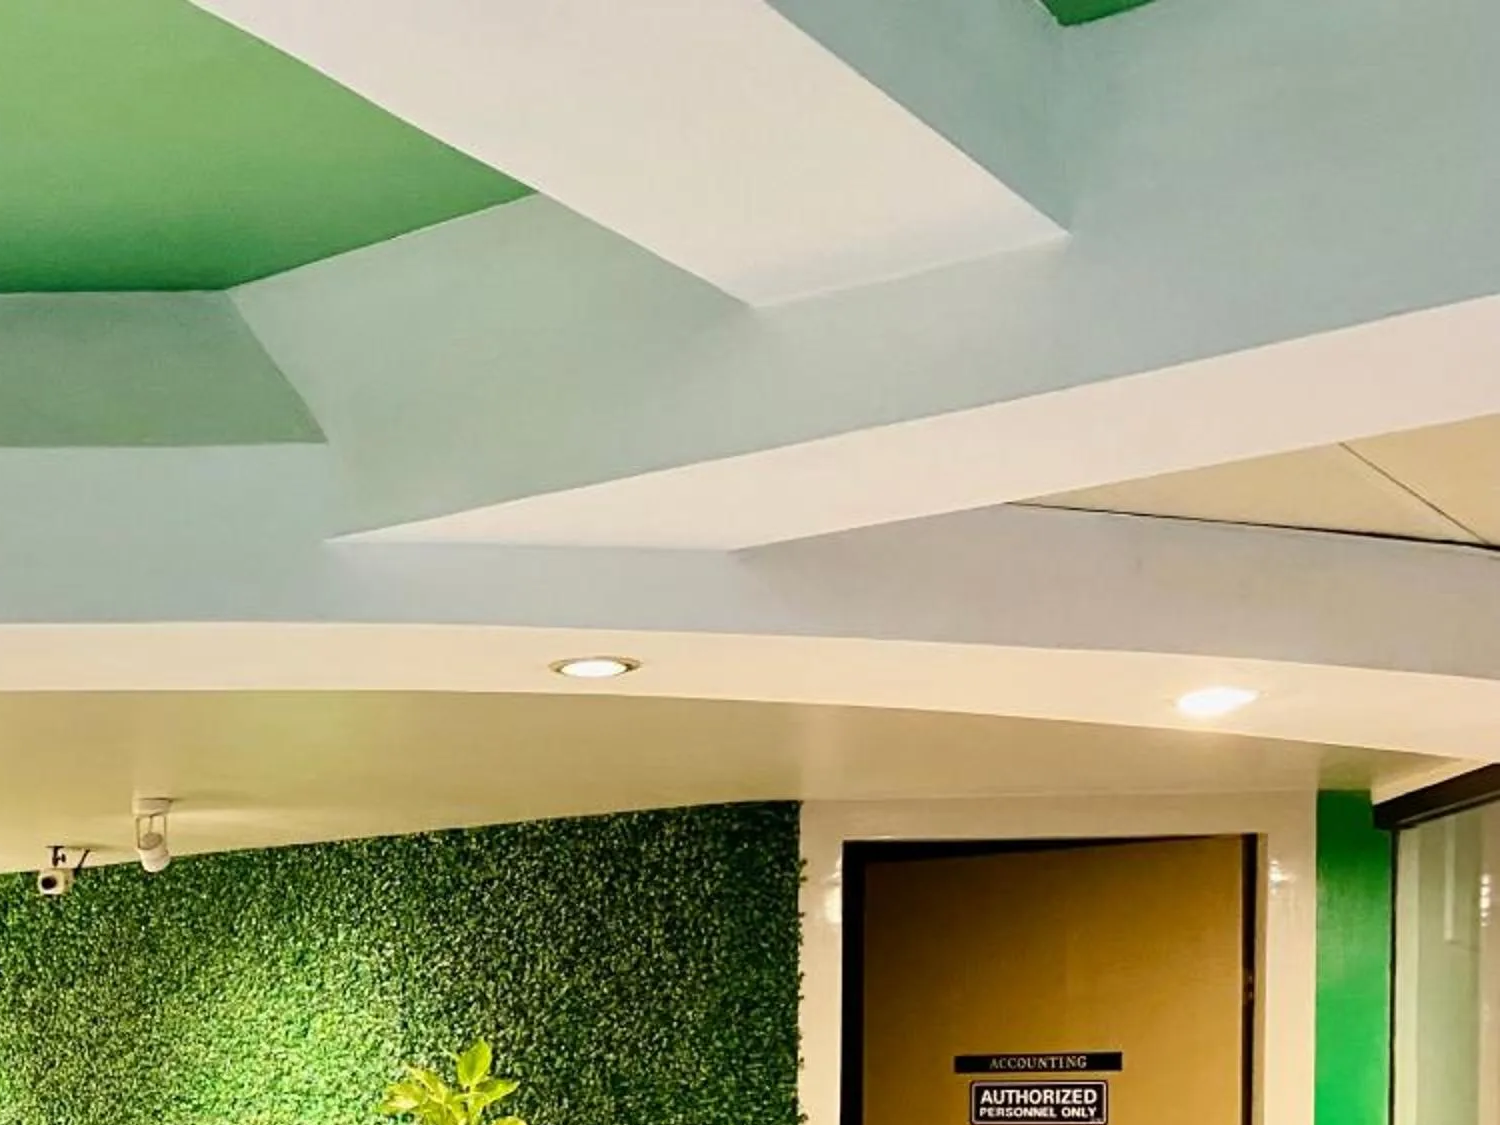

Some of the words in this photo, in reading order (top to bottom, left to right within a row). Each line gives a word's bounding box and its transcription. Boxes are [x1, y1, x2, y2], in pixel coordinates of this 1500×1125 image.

[990, 1055, 1087, 1069] ACCOUNTING
[980, 1089, 1097, 1105] AUTHORIZED
[979, 1107, 1057, 1118] PERSONNEL
[1061, 1107, 1097, 1118] ONLY
